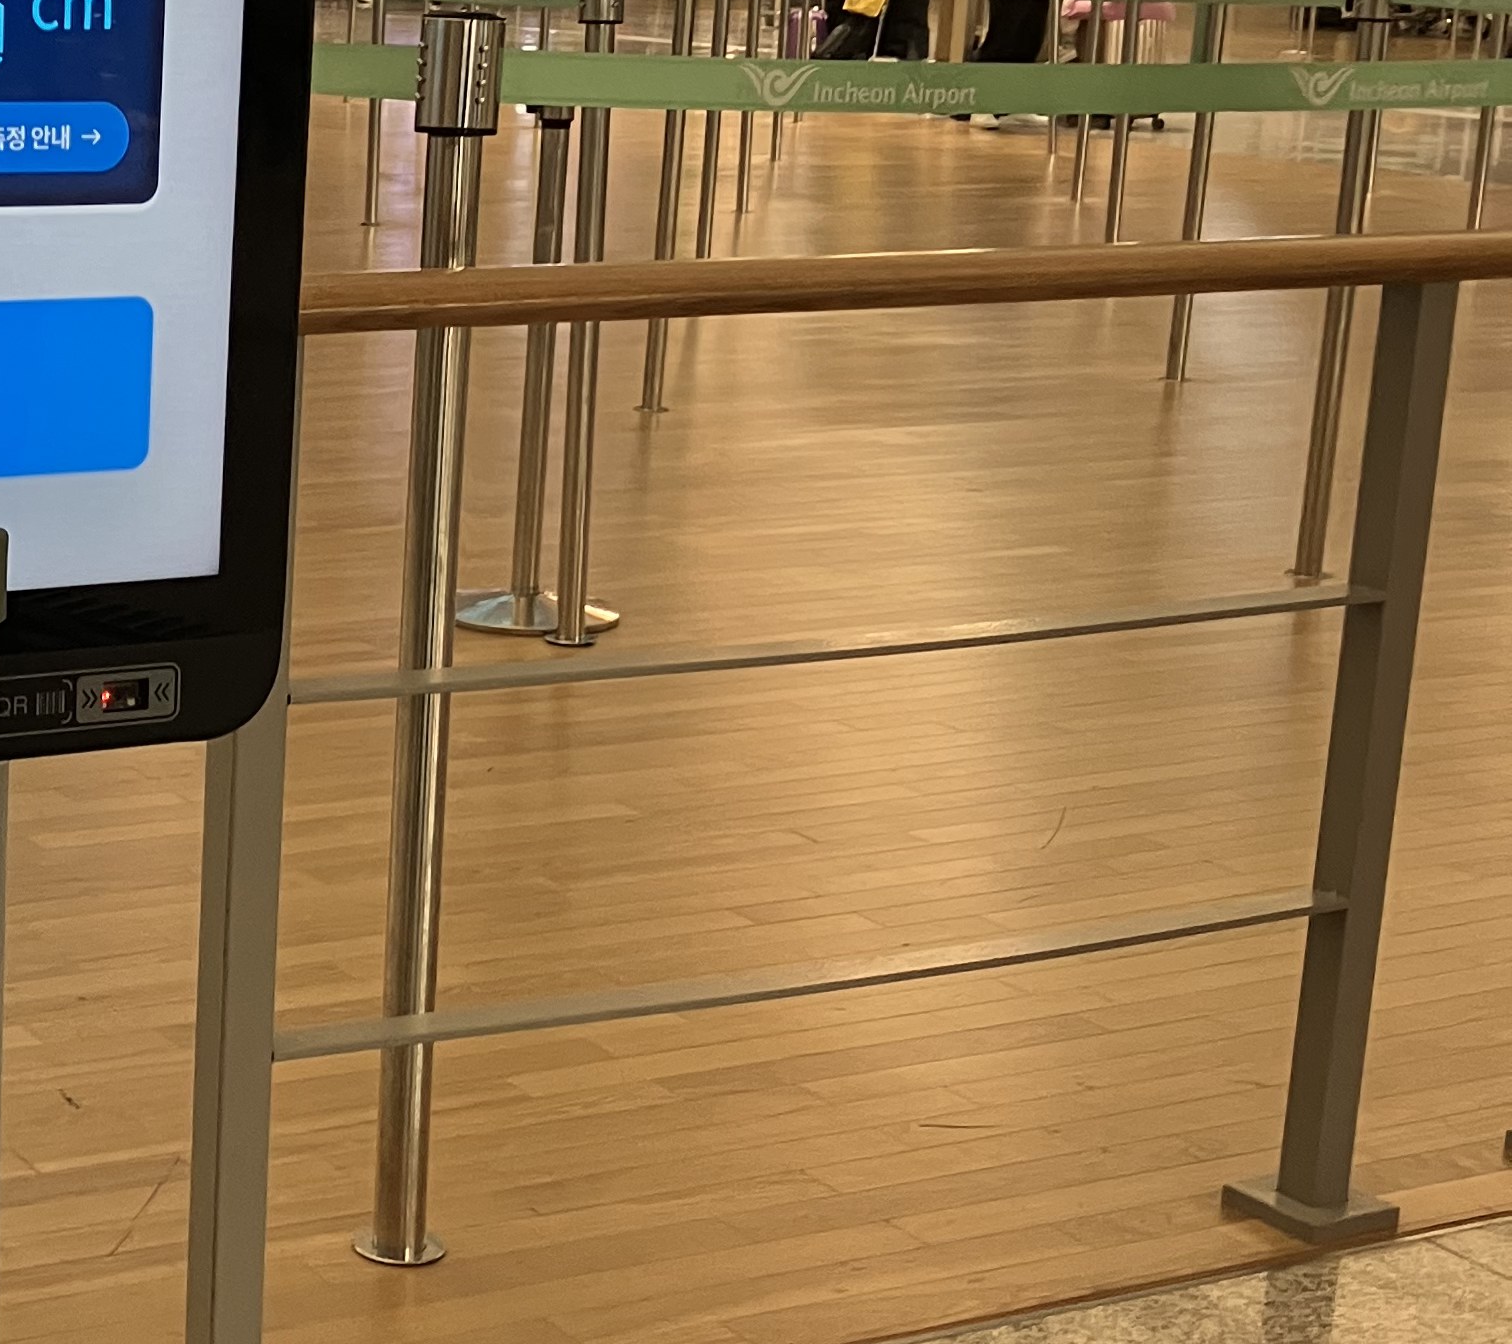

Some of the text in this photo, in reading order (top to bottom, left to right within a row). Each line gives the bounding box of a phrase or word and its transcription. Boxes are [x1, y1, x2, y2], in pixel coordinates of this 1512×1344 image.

[813, 81, 976, 108] Incheon Airport
[31, 125, 71, 151] 안내
